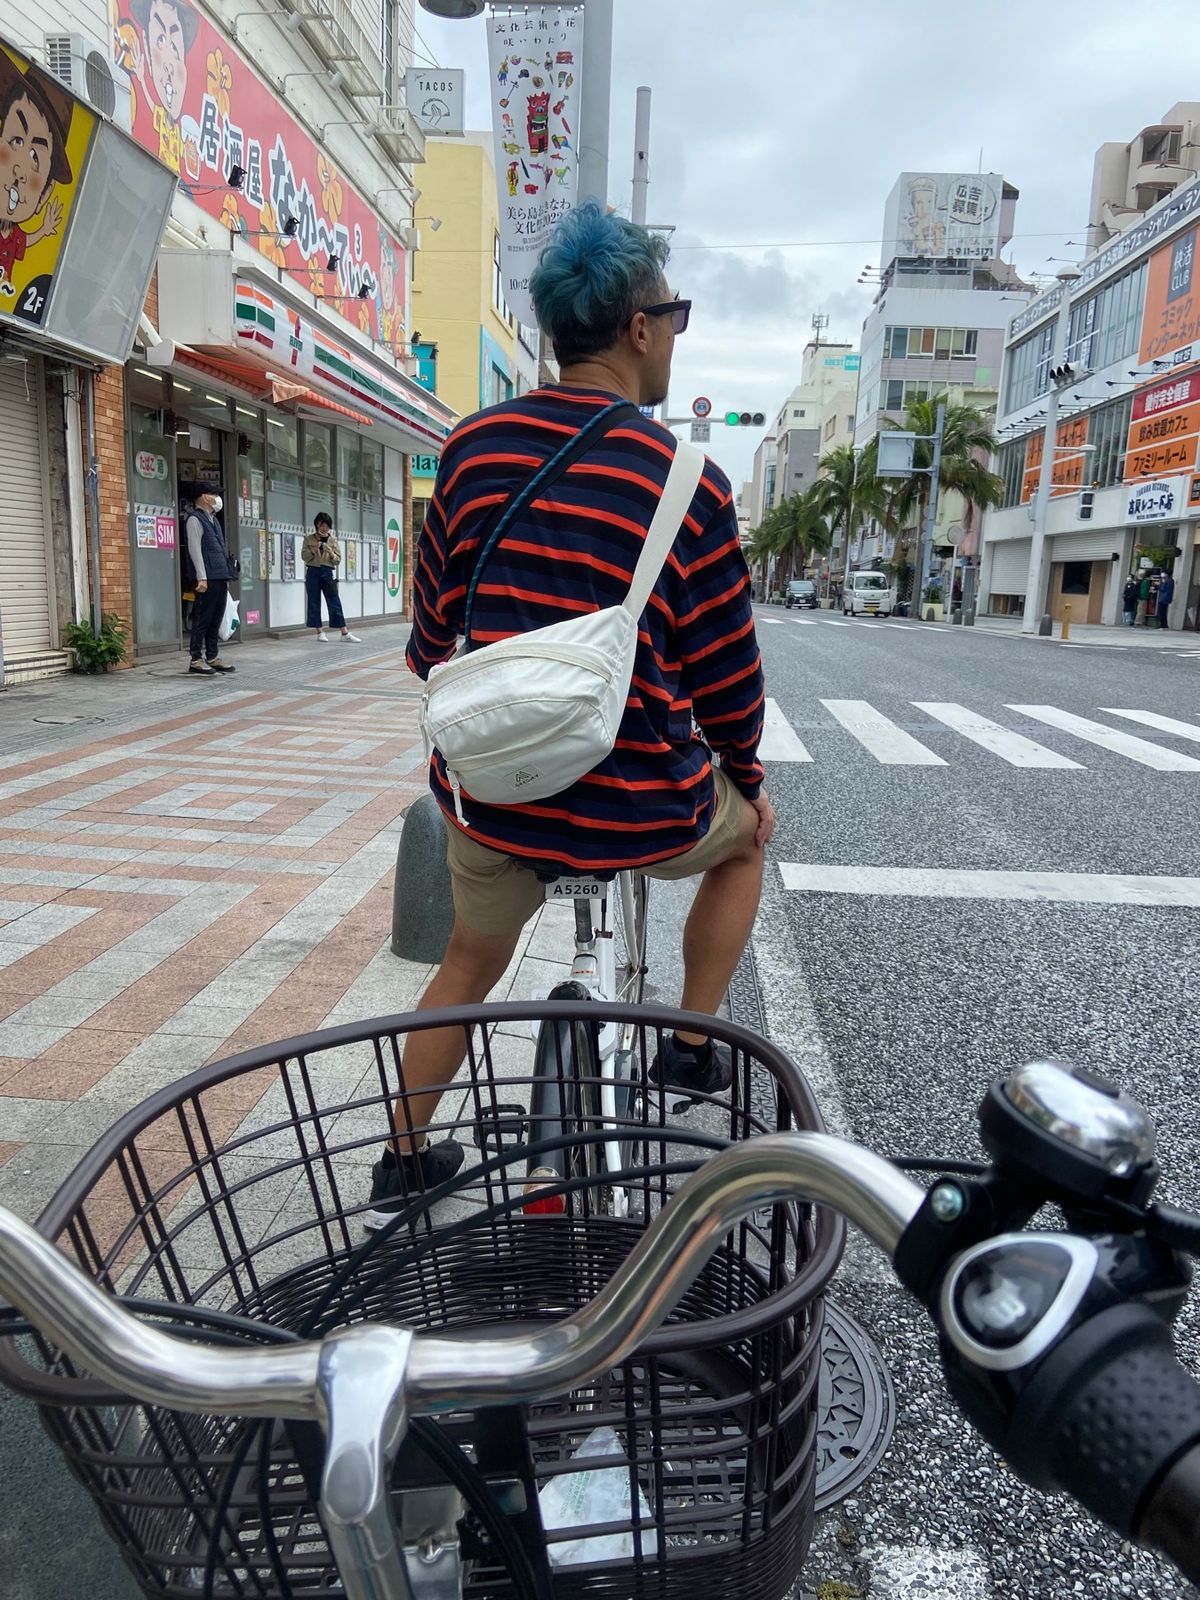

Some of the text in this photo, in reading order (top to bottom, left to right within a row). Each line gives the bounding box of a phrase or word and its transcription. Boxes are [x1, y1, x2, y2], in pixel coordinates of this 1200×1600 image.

[495, 17, 576, 33] 文化芸術の花
[419, 81, 453, 92] TACOS
[199, 95, 264, 209] 居酒屋
[956, 184, 982, 201] 広告
[1171, 270, 1190, 291] CLUB
[23, 286, 44, 314] 2F
[1160, 297, 1193, 329] コミック
[1138, 415, 1189, 443] 飲み放題カフェ
[1133, 444, 1187, 472] ファミリールーム
[158, 524, 175, 545] SIM
[553, 884, 599, 895] A5260
